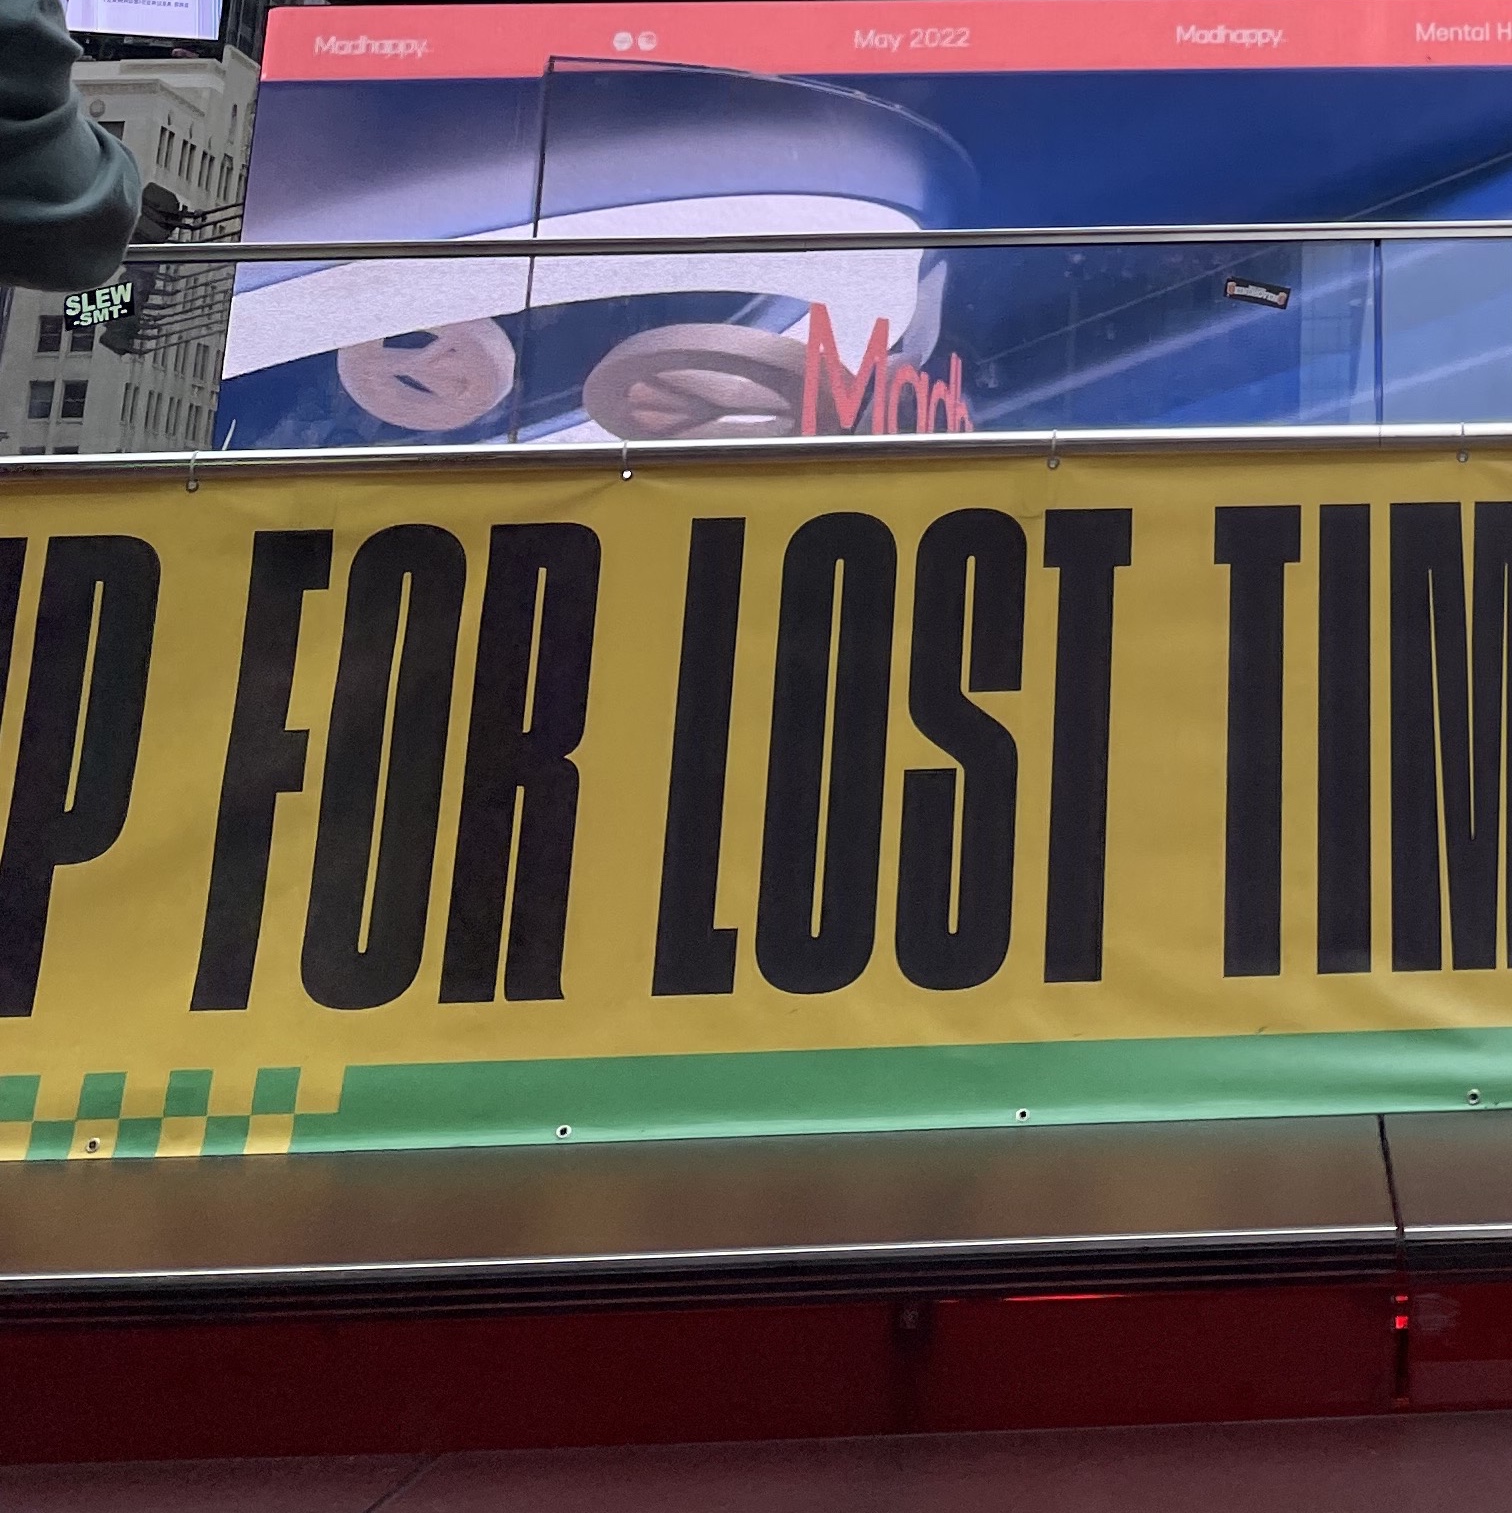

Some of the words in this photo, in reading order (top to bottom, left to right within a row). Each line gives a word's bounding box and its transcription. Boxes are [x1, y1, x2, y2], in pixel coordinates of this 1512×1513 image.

[853, 28, 902, 52] May
[909, 28, 970, 48] 2022
[1416, 21, 1490, 42] Mental
[65, 282, 133, 316] SLEW
[190, 522, 601, 1012] FOR
[651, 507, 1133, 996] LOST
